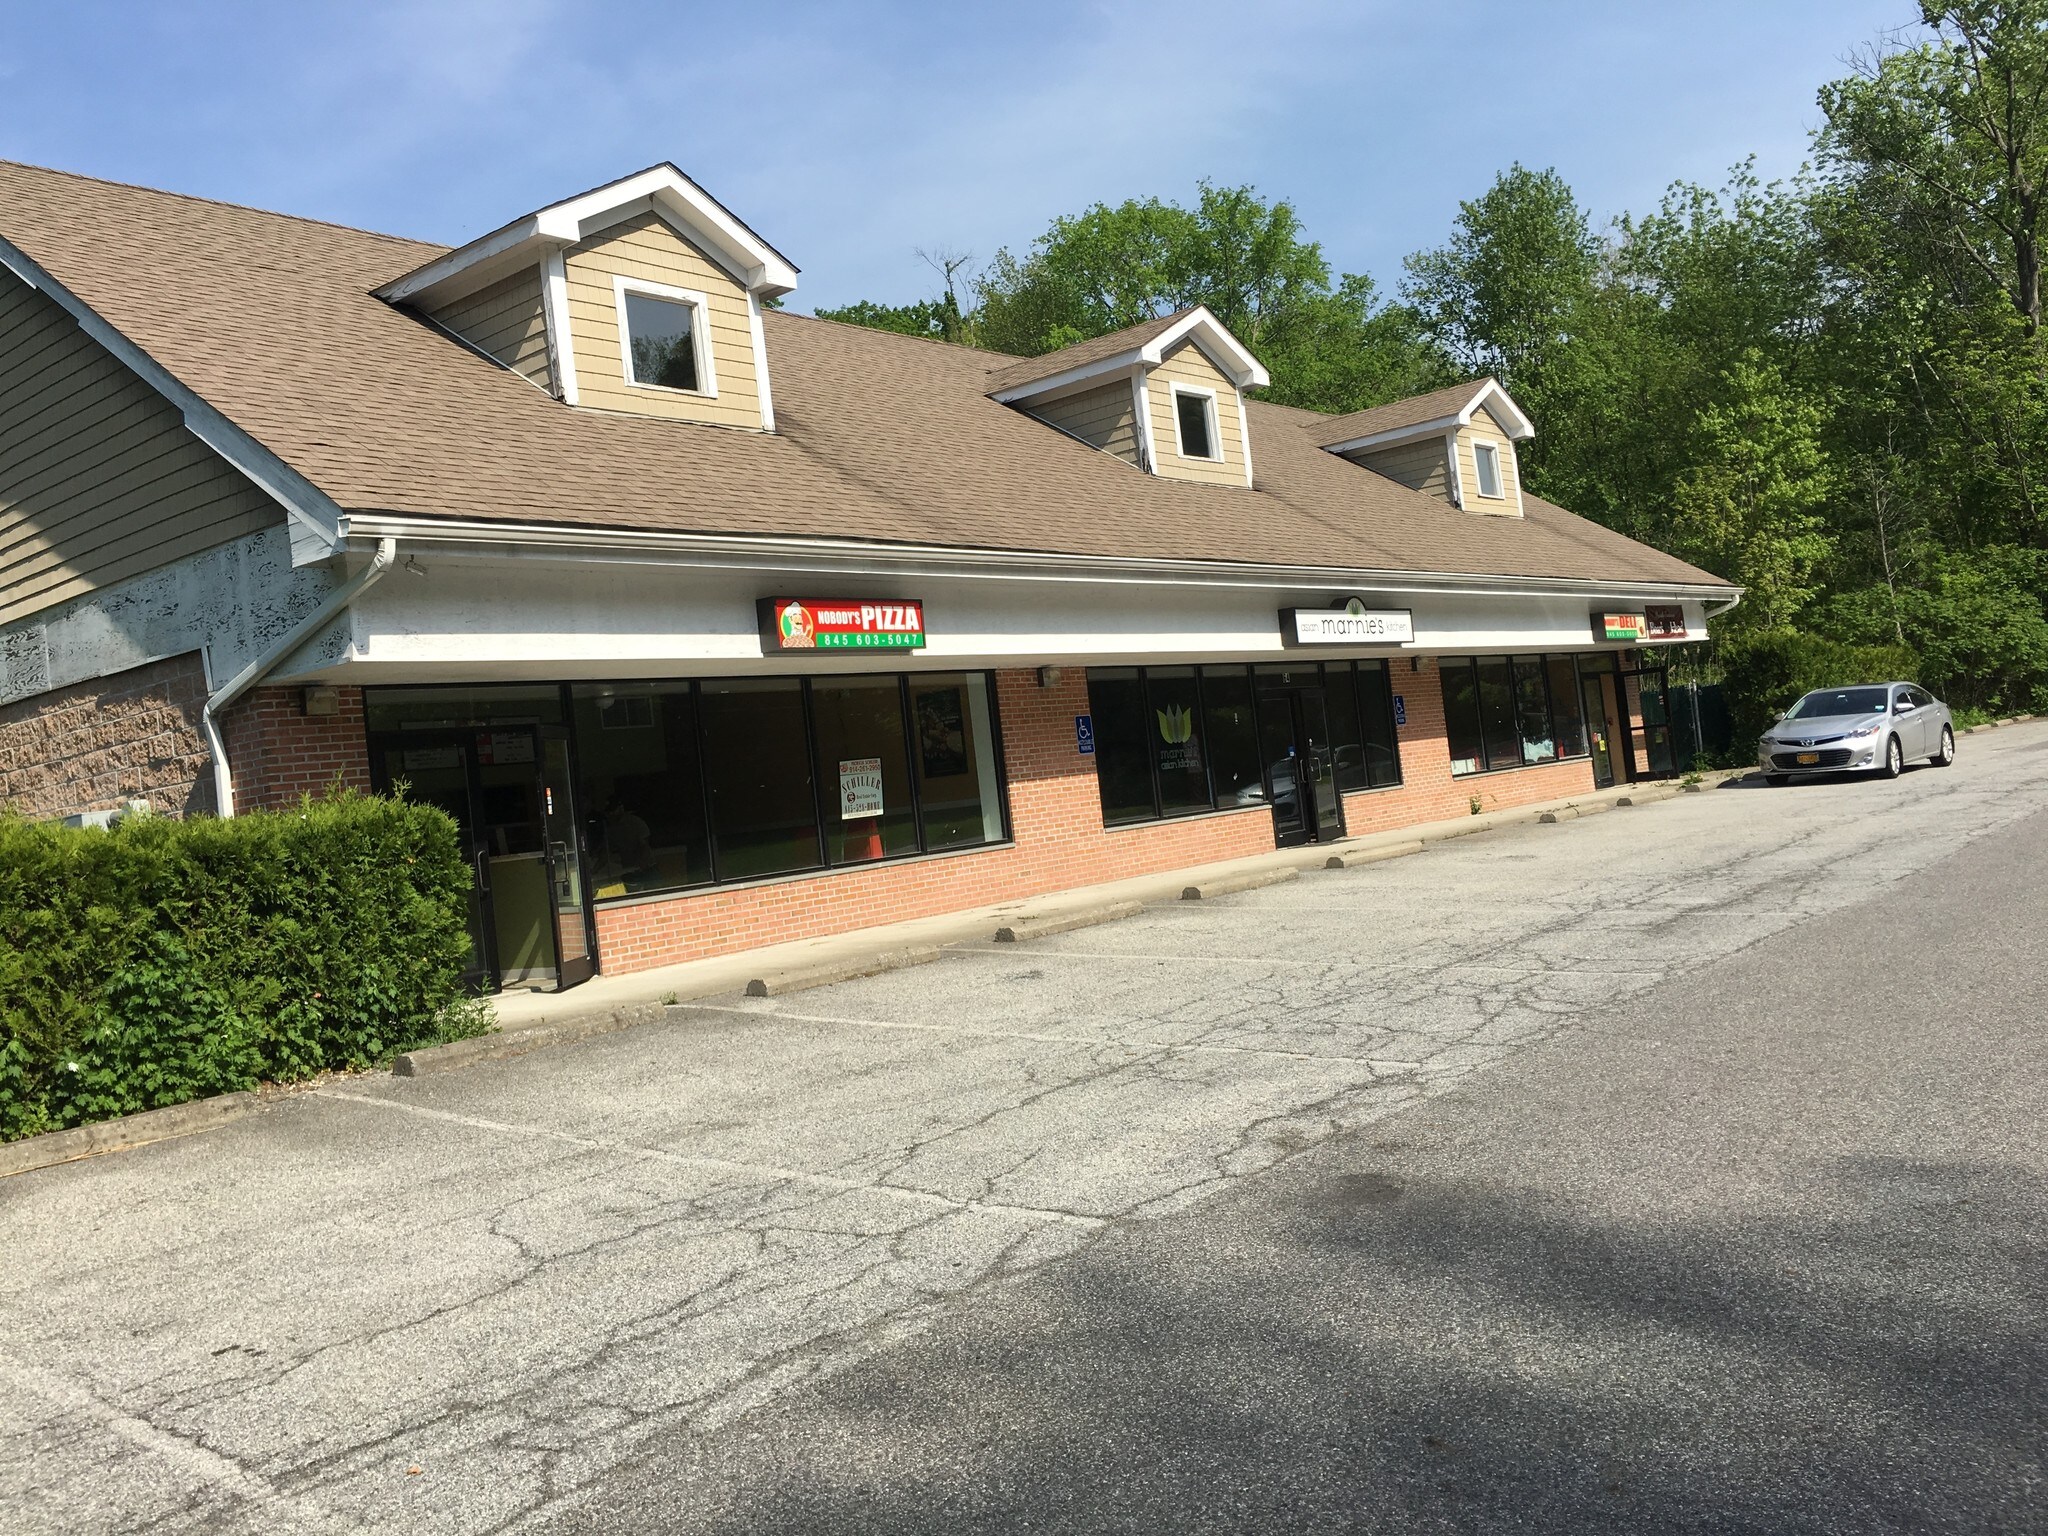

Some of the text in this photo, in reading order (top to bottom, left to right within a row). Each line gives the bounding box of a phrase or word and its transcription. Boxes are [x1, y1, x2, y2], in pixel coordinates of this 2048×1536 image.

[817, 605, 920, 630] NOBODY'S PIZZA
[1321, 613, 1385, 634] marnie's
[1619, 615, 1637, 628] DELI
[824, 634, 917, 646] 845 603-5047
[842, 776, 880, 794] SCHILLER
